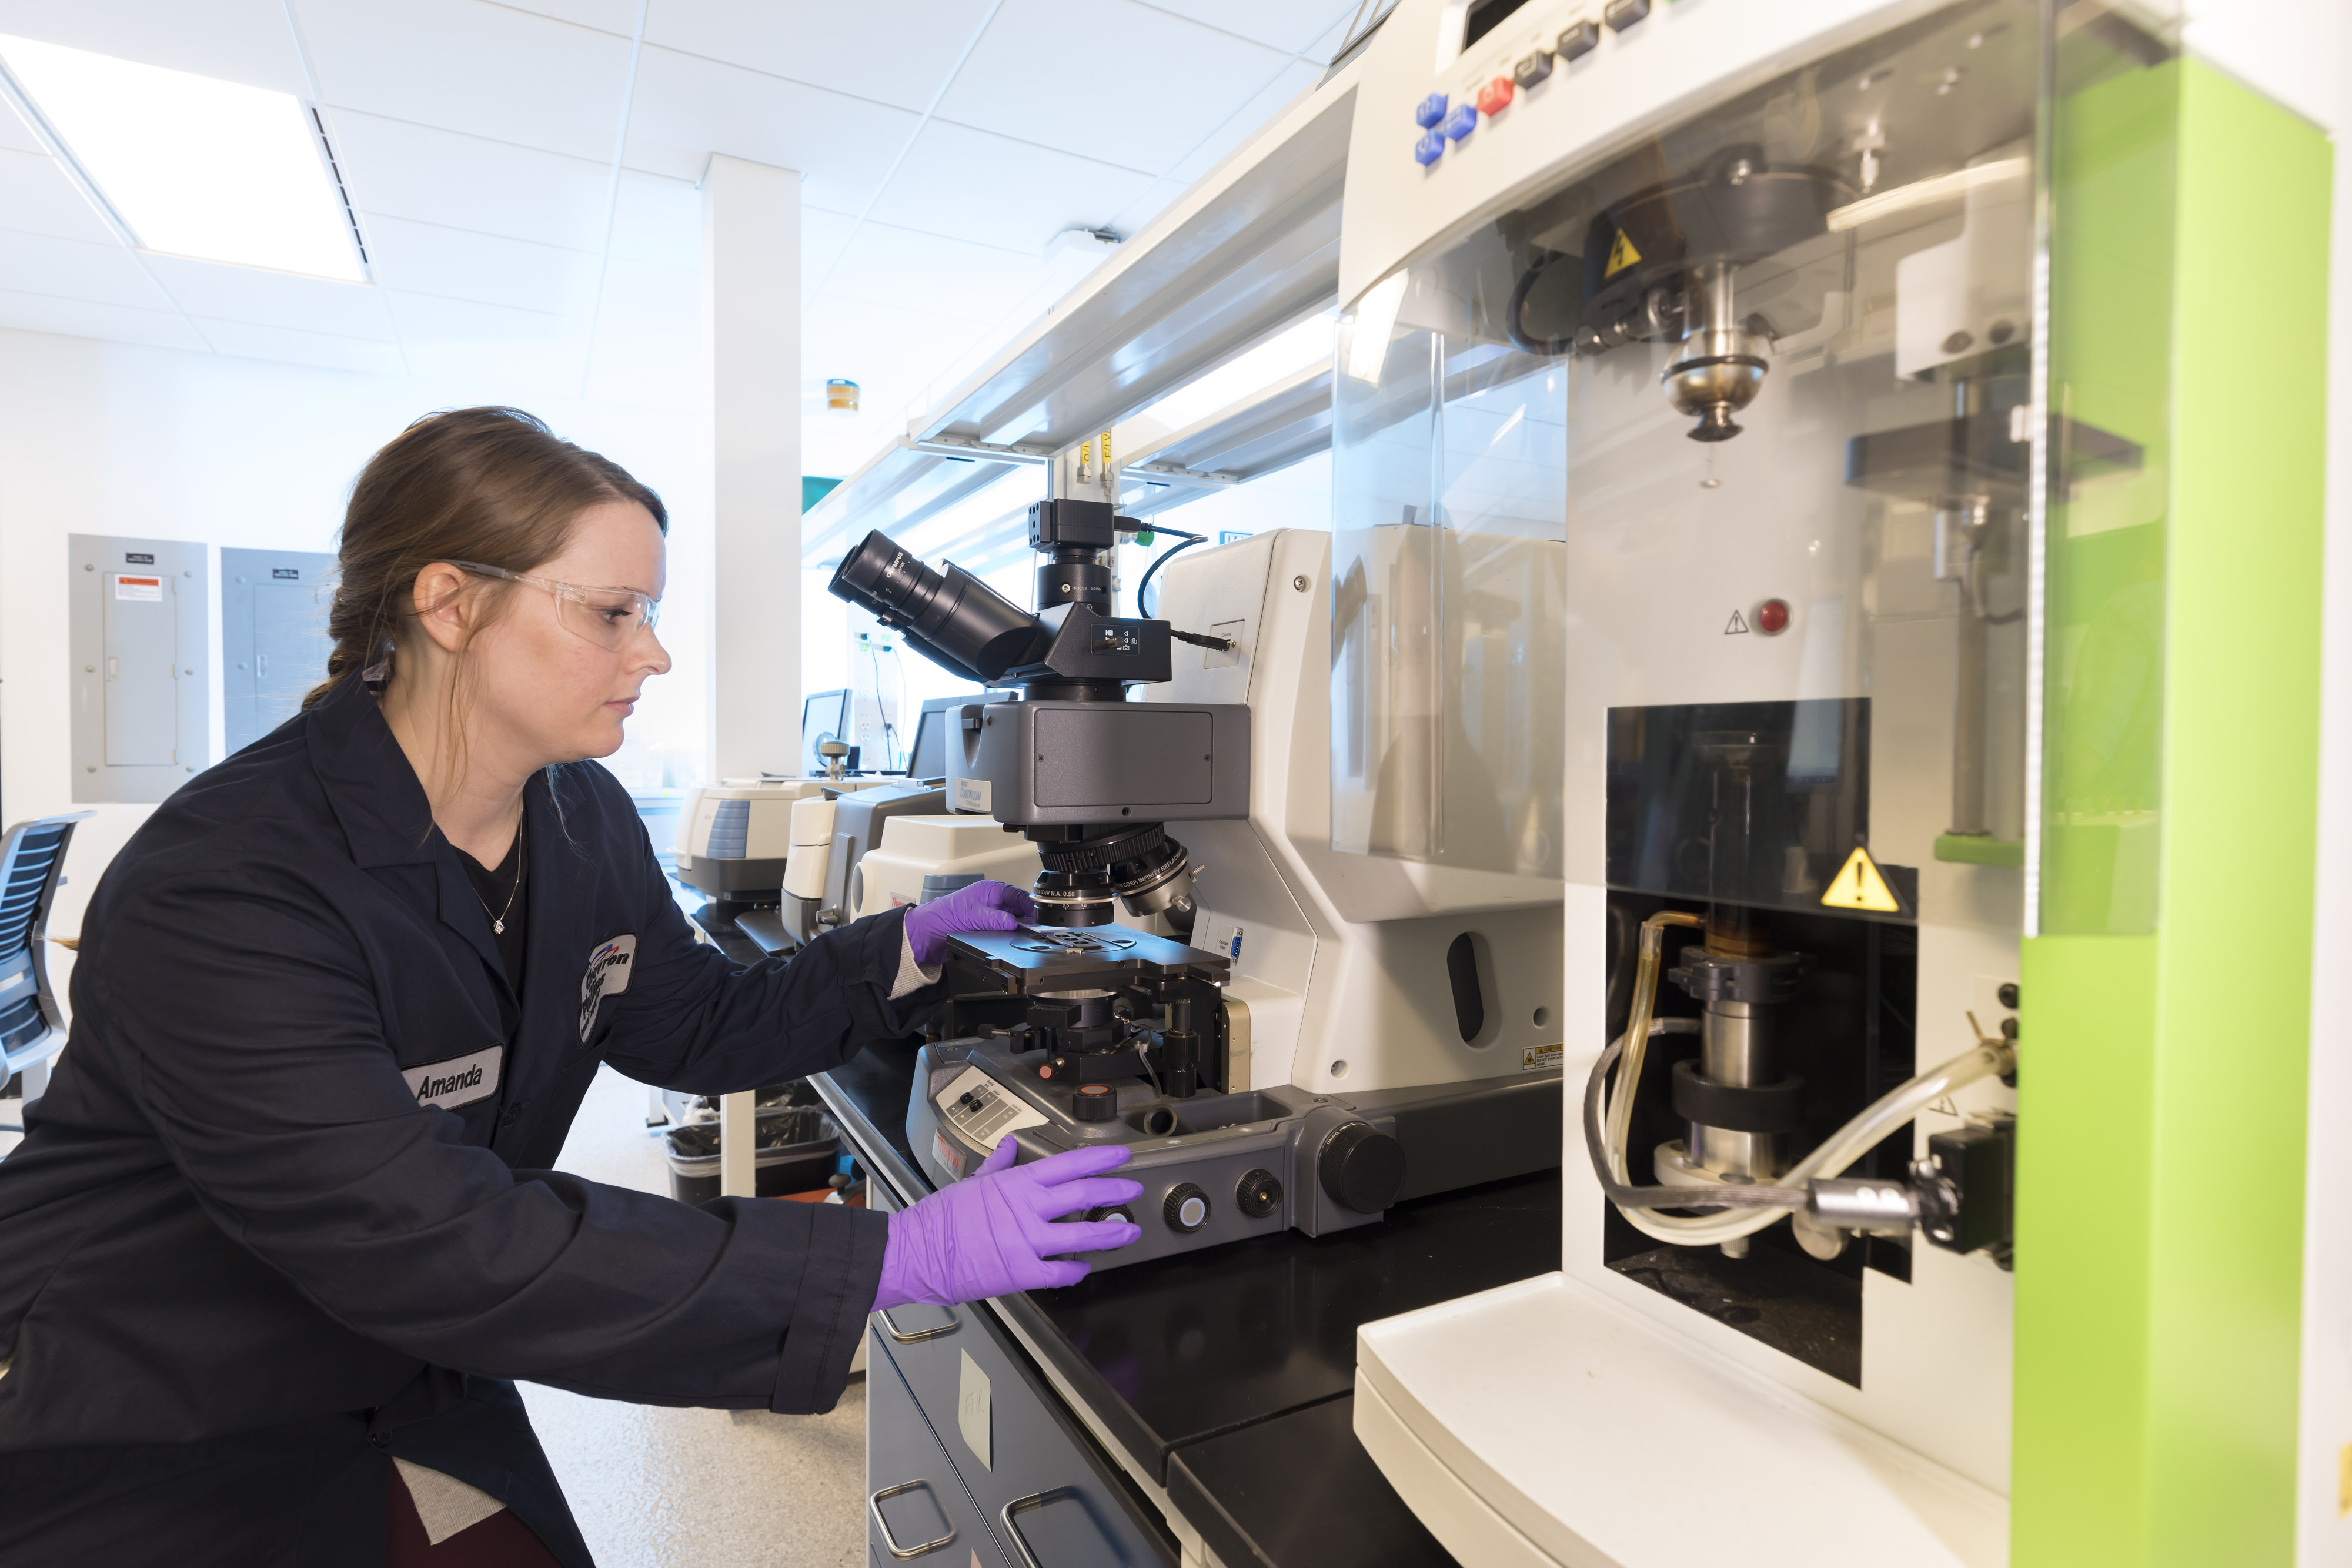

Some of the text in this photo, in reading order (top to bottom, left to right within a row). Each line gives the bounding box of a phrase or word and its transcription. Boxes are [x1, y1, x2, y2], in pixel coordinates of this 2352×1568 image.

[886, 551, 903, 578] OLYMPUS
[1138, 868, 1161, 883] INFINITY
[586, 952, 630, 991] Chevron
[582, 973, 606, 1021] Phillips
[417, 1064, 482, 1101] Amanda
[1327, 1131, 1339, 1145] Down
